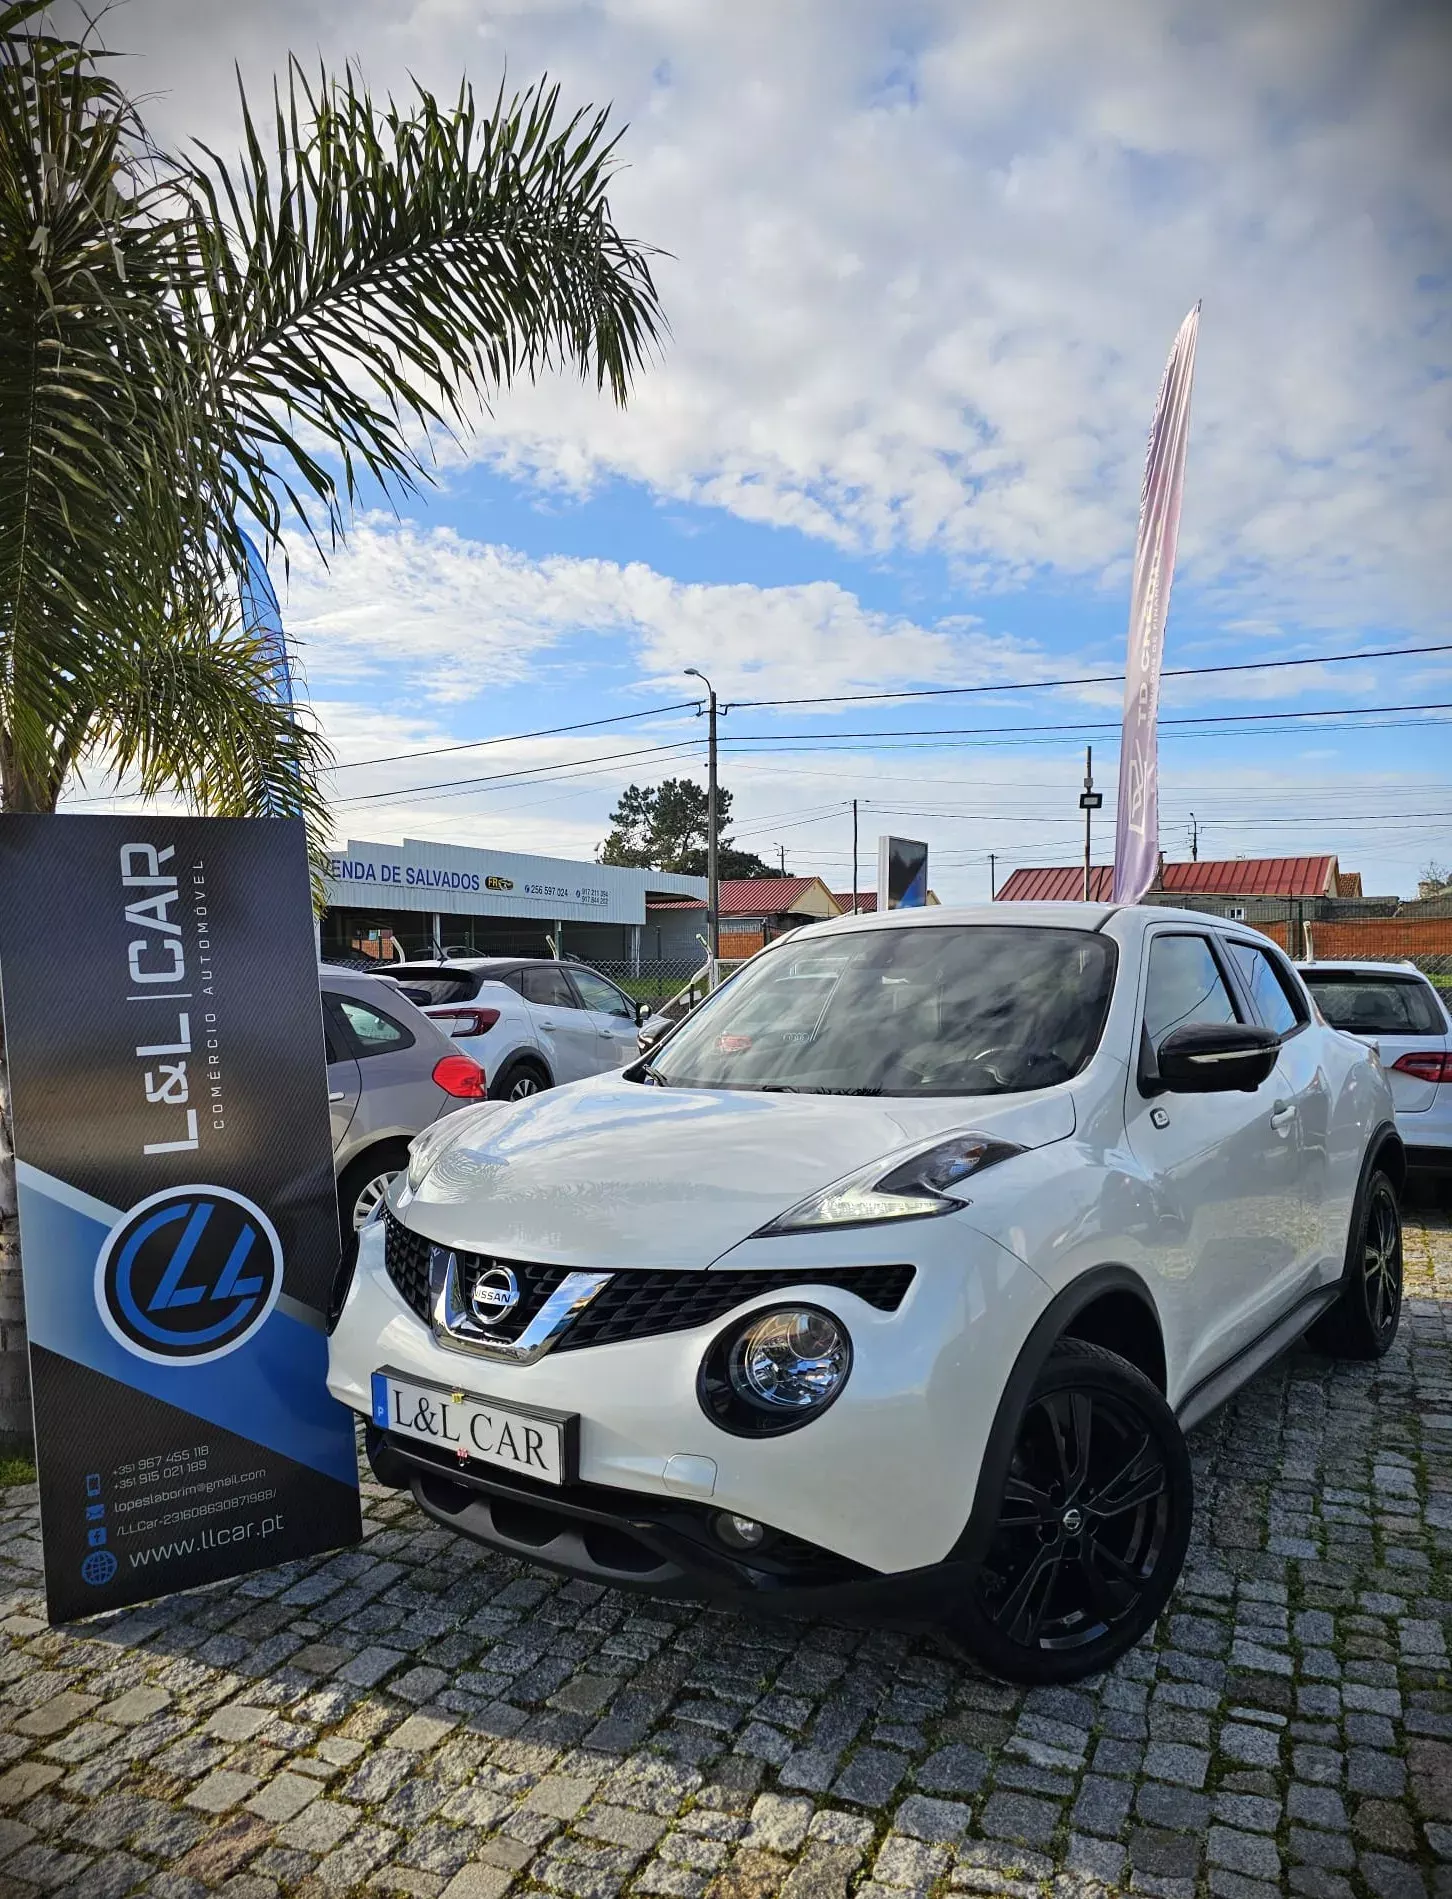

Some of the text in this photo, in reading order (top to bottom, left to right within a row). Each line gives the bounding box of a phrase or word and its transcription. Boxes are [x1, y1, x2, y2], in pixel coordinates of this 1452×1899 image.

[381, 864, 401, 883] DE
[406, 867, 480, 891] SALVADOS
[531, 884, 569, 897] 256 597 024
[120, 842, 199, 1155] L&L CAR
[191, 860, 226, 1130] COMÉRCIO AUTOMÓVEL
[474, 1289, 511, 1303] NISSAN
[377, 1406, 385, 1417] P
[393, 1388, 550, 1471] L&L CAR
[113, 1445, 209, 1475] +351 967 455 118
[114, 1459, 207, 1490] +351 915 021 189
[114, 1468, 266, 1513] lopeslaborim@gmail.com
[129, 1513, 285, 1568] www.llcar.pt
